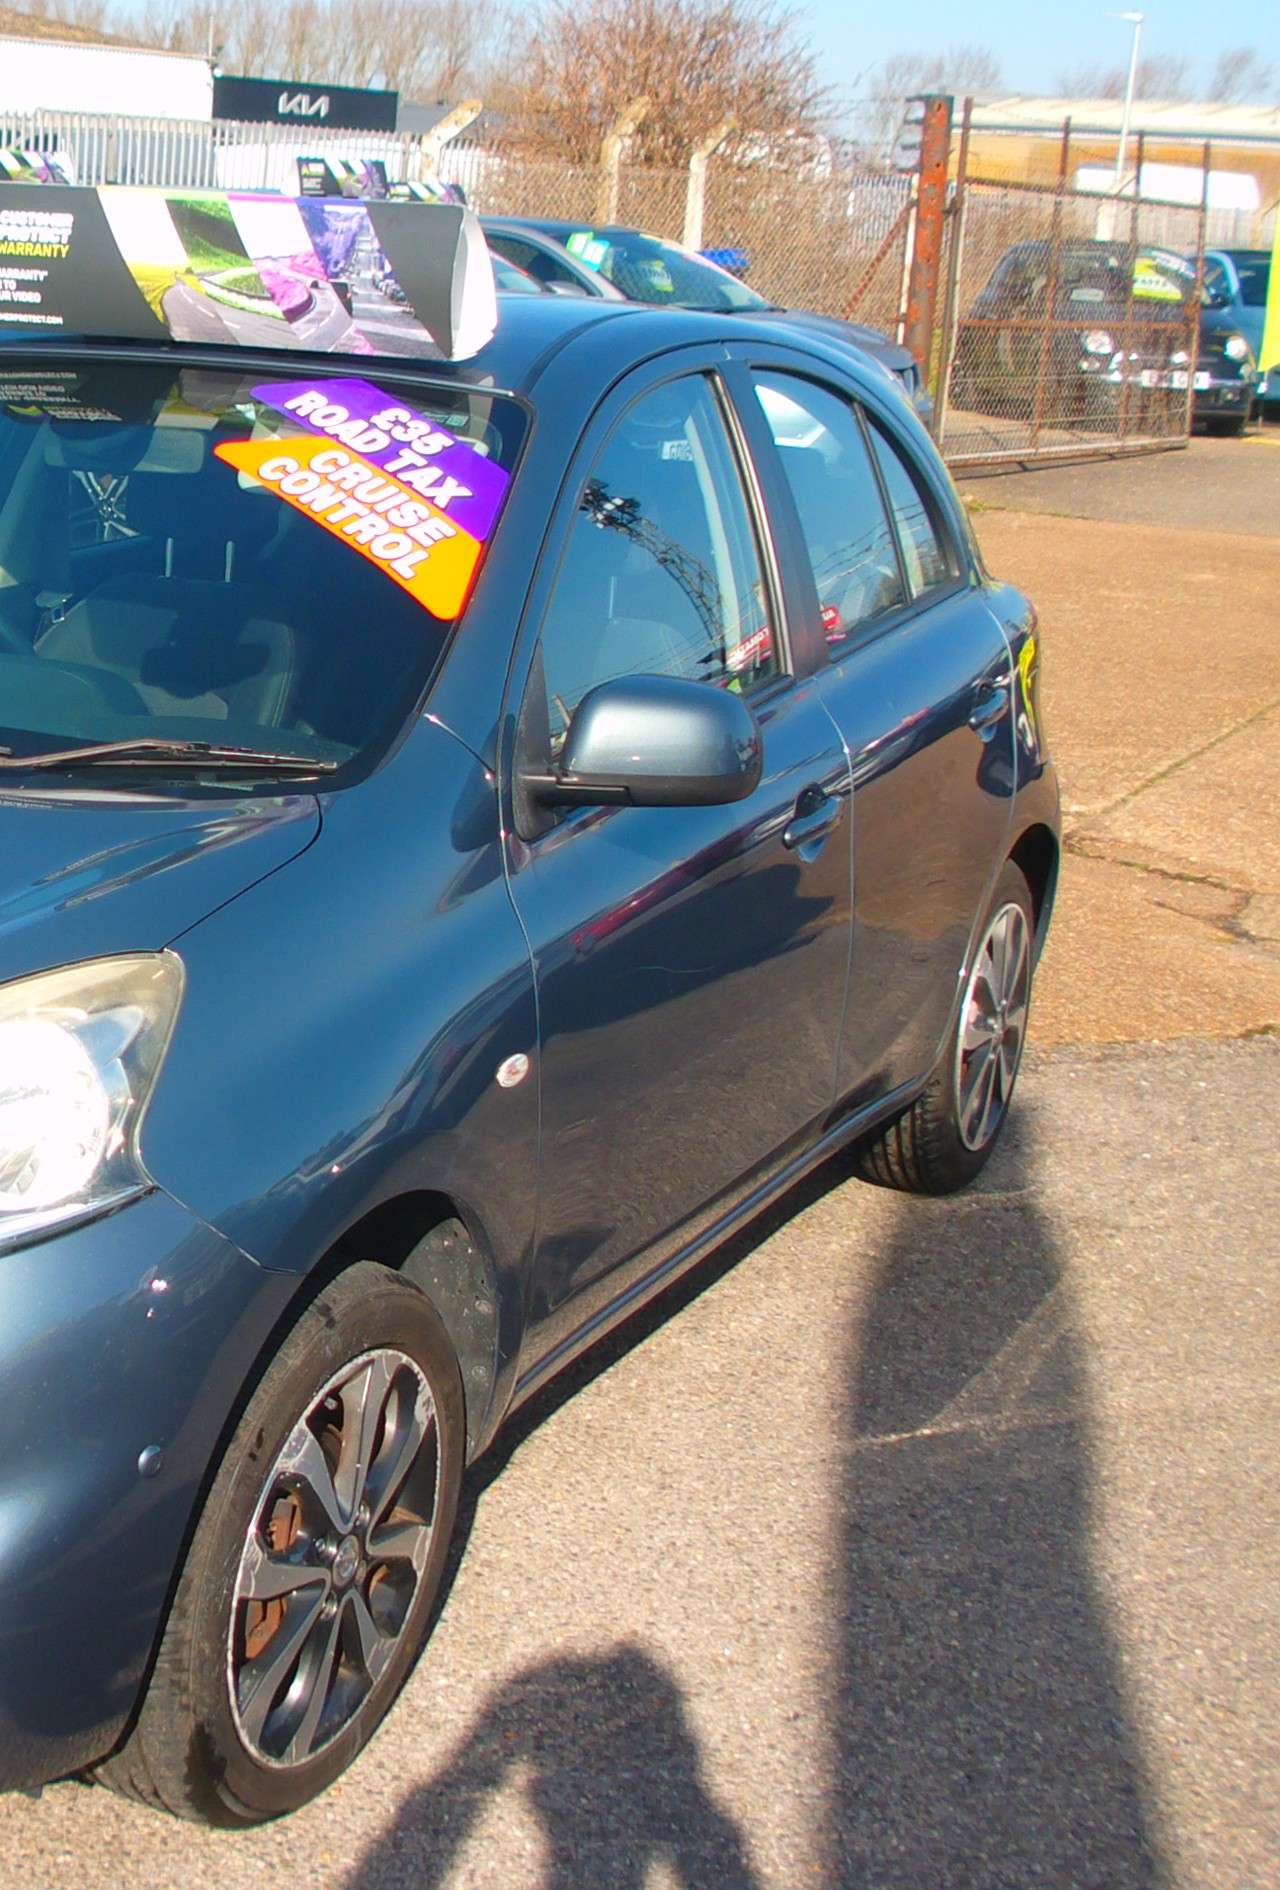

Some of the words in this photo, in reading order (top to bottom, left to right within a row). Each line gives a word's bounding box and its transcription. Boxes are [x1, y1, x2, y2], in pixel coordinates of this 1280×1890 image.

[0, 210, 73, 228] CUSTOMER
[12, 291, 42, 304] VIDEO
[284, 390, 391, 454] ROAD
[384, 448, 473, 510] TAX
[371, 407, 455, 456] £35
[258, 456, 430, 580] CONTROL
[309, 450, 457, 548] CRUISE
